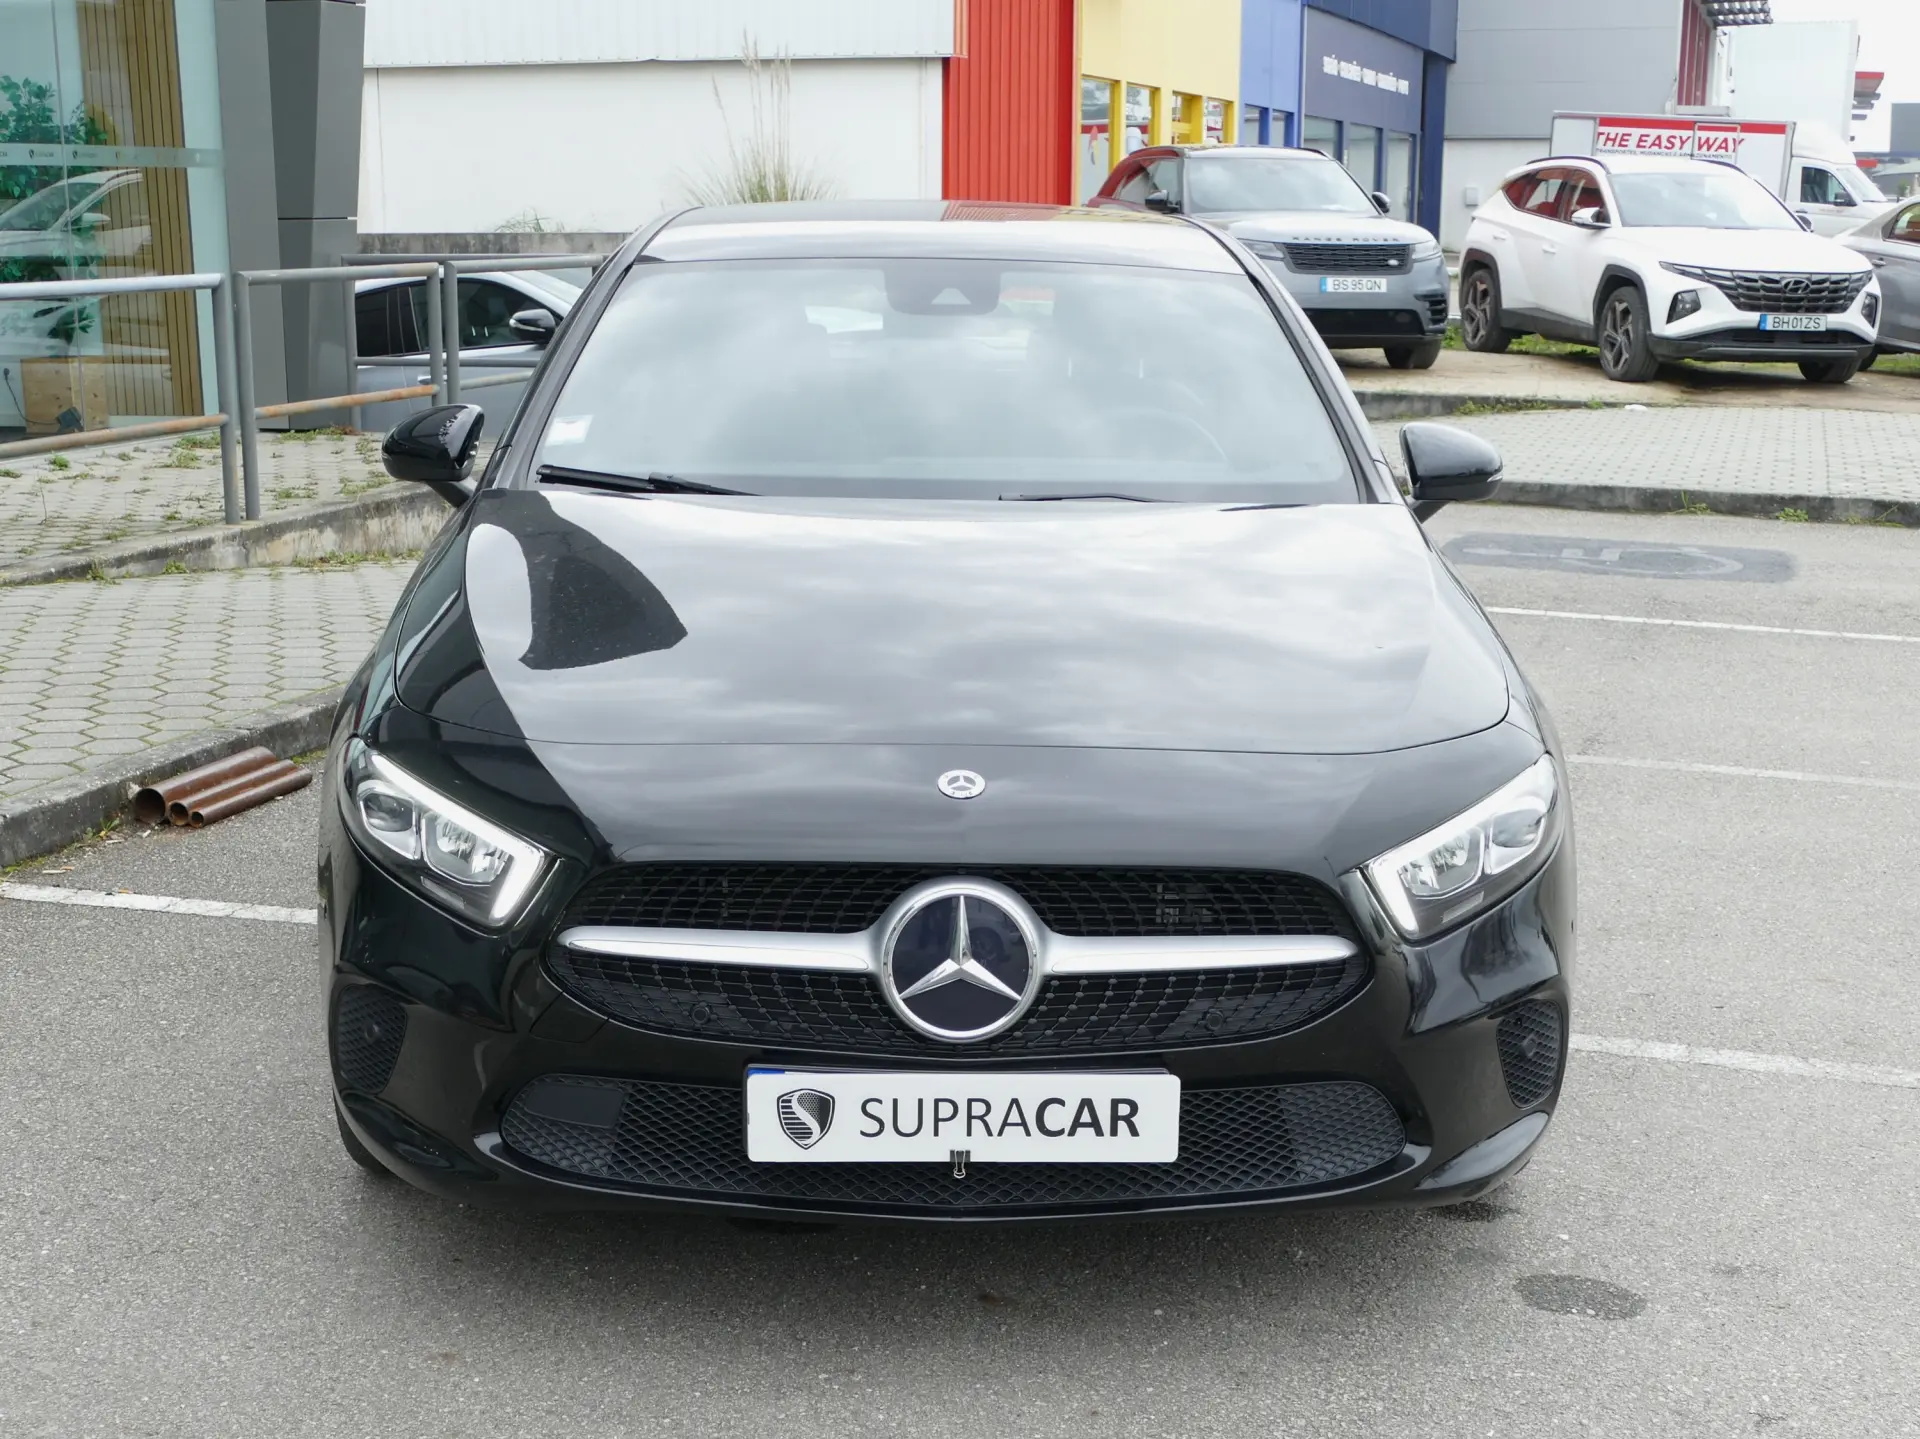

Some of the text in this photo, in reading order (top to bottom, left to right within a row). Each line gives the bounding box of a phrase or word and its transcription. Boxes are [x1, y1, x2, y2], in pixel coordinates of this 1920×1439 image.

[1595, 131, 1746, 153] THE EASY WAY
[859, 1096, 1141, 1138] SUPRACAR
